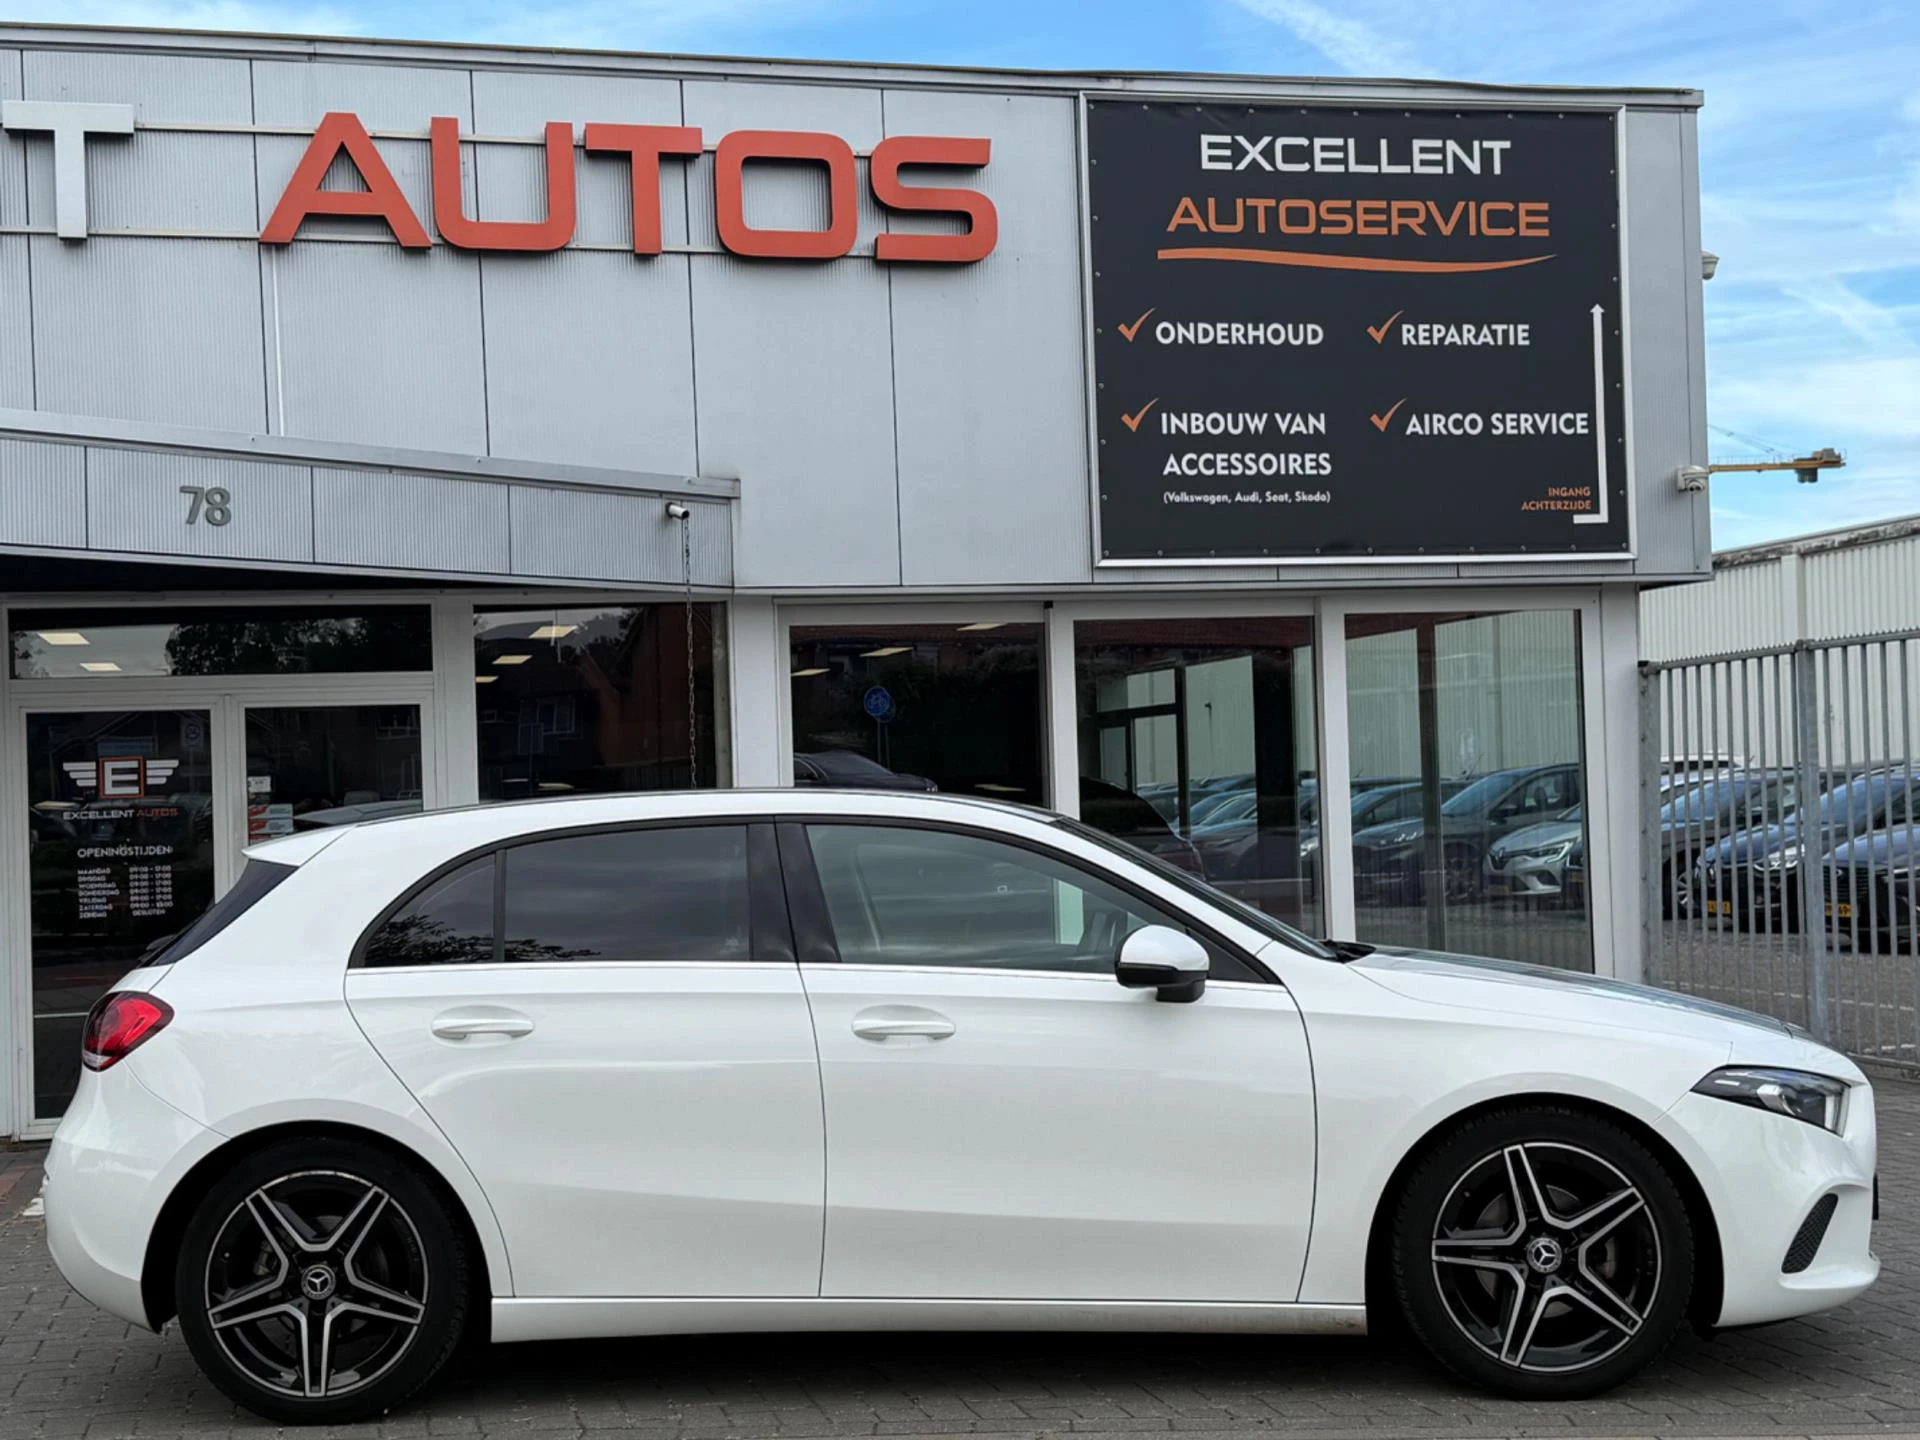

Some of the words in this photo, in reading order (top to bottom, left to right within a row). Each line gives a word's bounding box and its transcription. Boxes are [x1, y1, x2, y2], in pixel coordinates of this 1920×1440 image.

[1200, 134, 1511, 175] EXCELLENT
[259, 112, 998, 263] AUTOS
[1167, 197, 1550, 237] AUTOSERVICE
[1155, 322, 1324, 346] ONDERHOUD
[1401, 323, 1531, 347] REPARATIE
[1161, 412, 1268, 435] INBOUW
[1274, 413, 1326, 435] VAN
[1405, 413, 1484, 436] AIRCO
[1491, 413, 1589, 435] SERVICE
[1163, 453, 1332, 476] ACCESSOIRES
[1163, 492, 1232, 504] (Volkswagen,
[1234, 492, 1262, 504] Audi,
[1264, 491, 1292, 503] Seat,
[1548, 487, 1591, 497] INGANG
[180, 486, 232, 526] 78
[1521, 501, 1592, 511] ACHTERZIJDE
[63, 809, 134, 820] EXCELLENT
[137, 808, 178, 817] AUTOS
